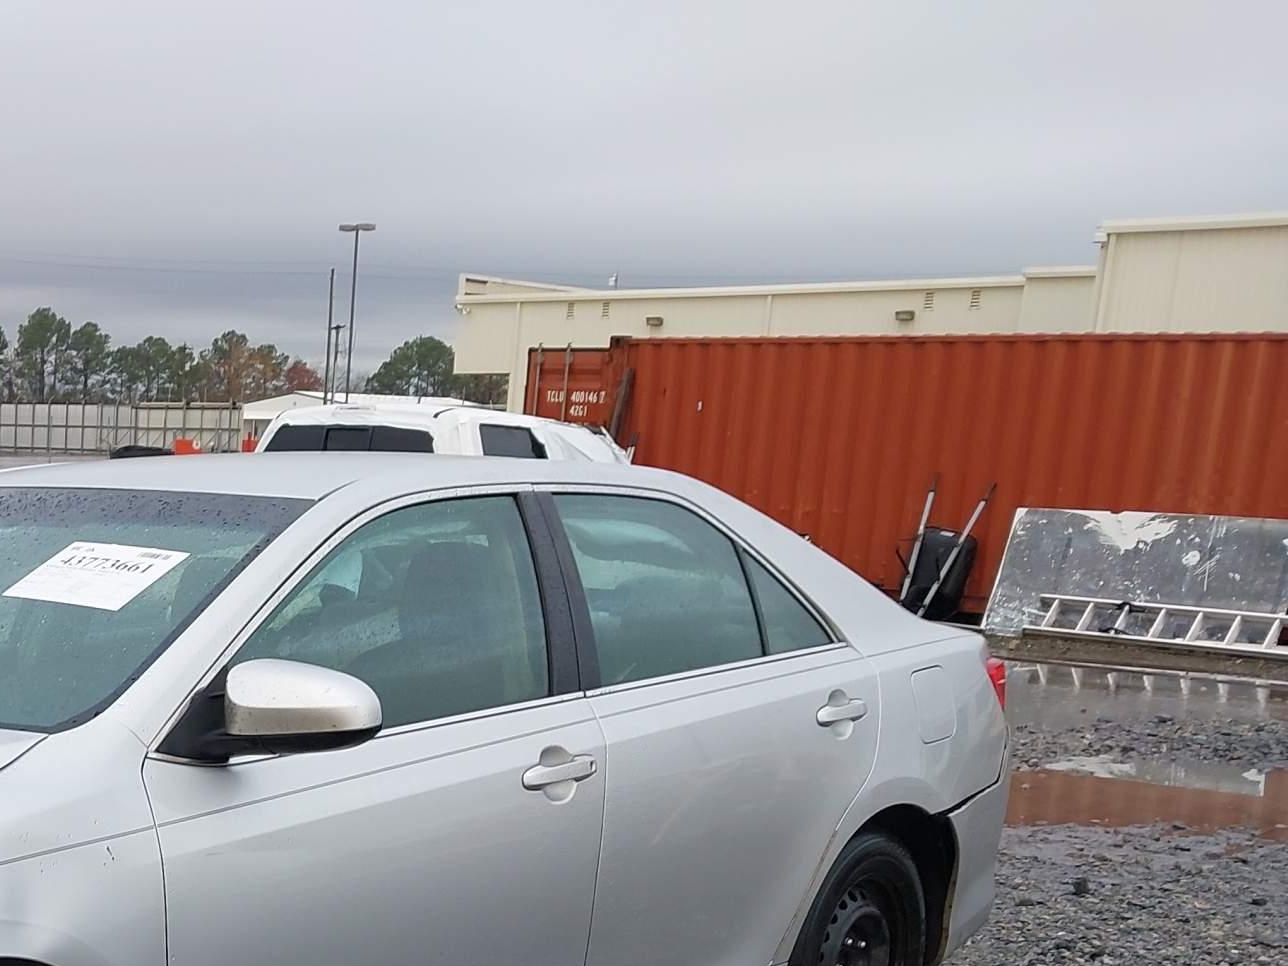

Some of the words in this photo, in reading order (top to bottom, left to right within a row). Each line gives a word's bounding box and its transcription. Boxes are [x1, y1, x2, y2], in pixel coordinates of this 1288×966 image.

[546, 389, 565, 403] TCLU
[570, 390, 598, 404] 400146
[59, 554, 155, 574] 43773661
